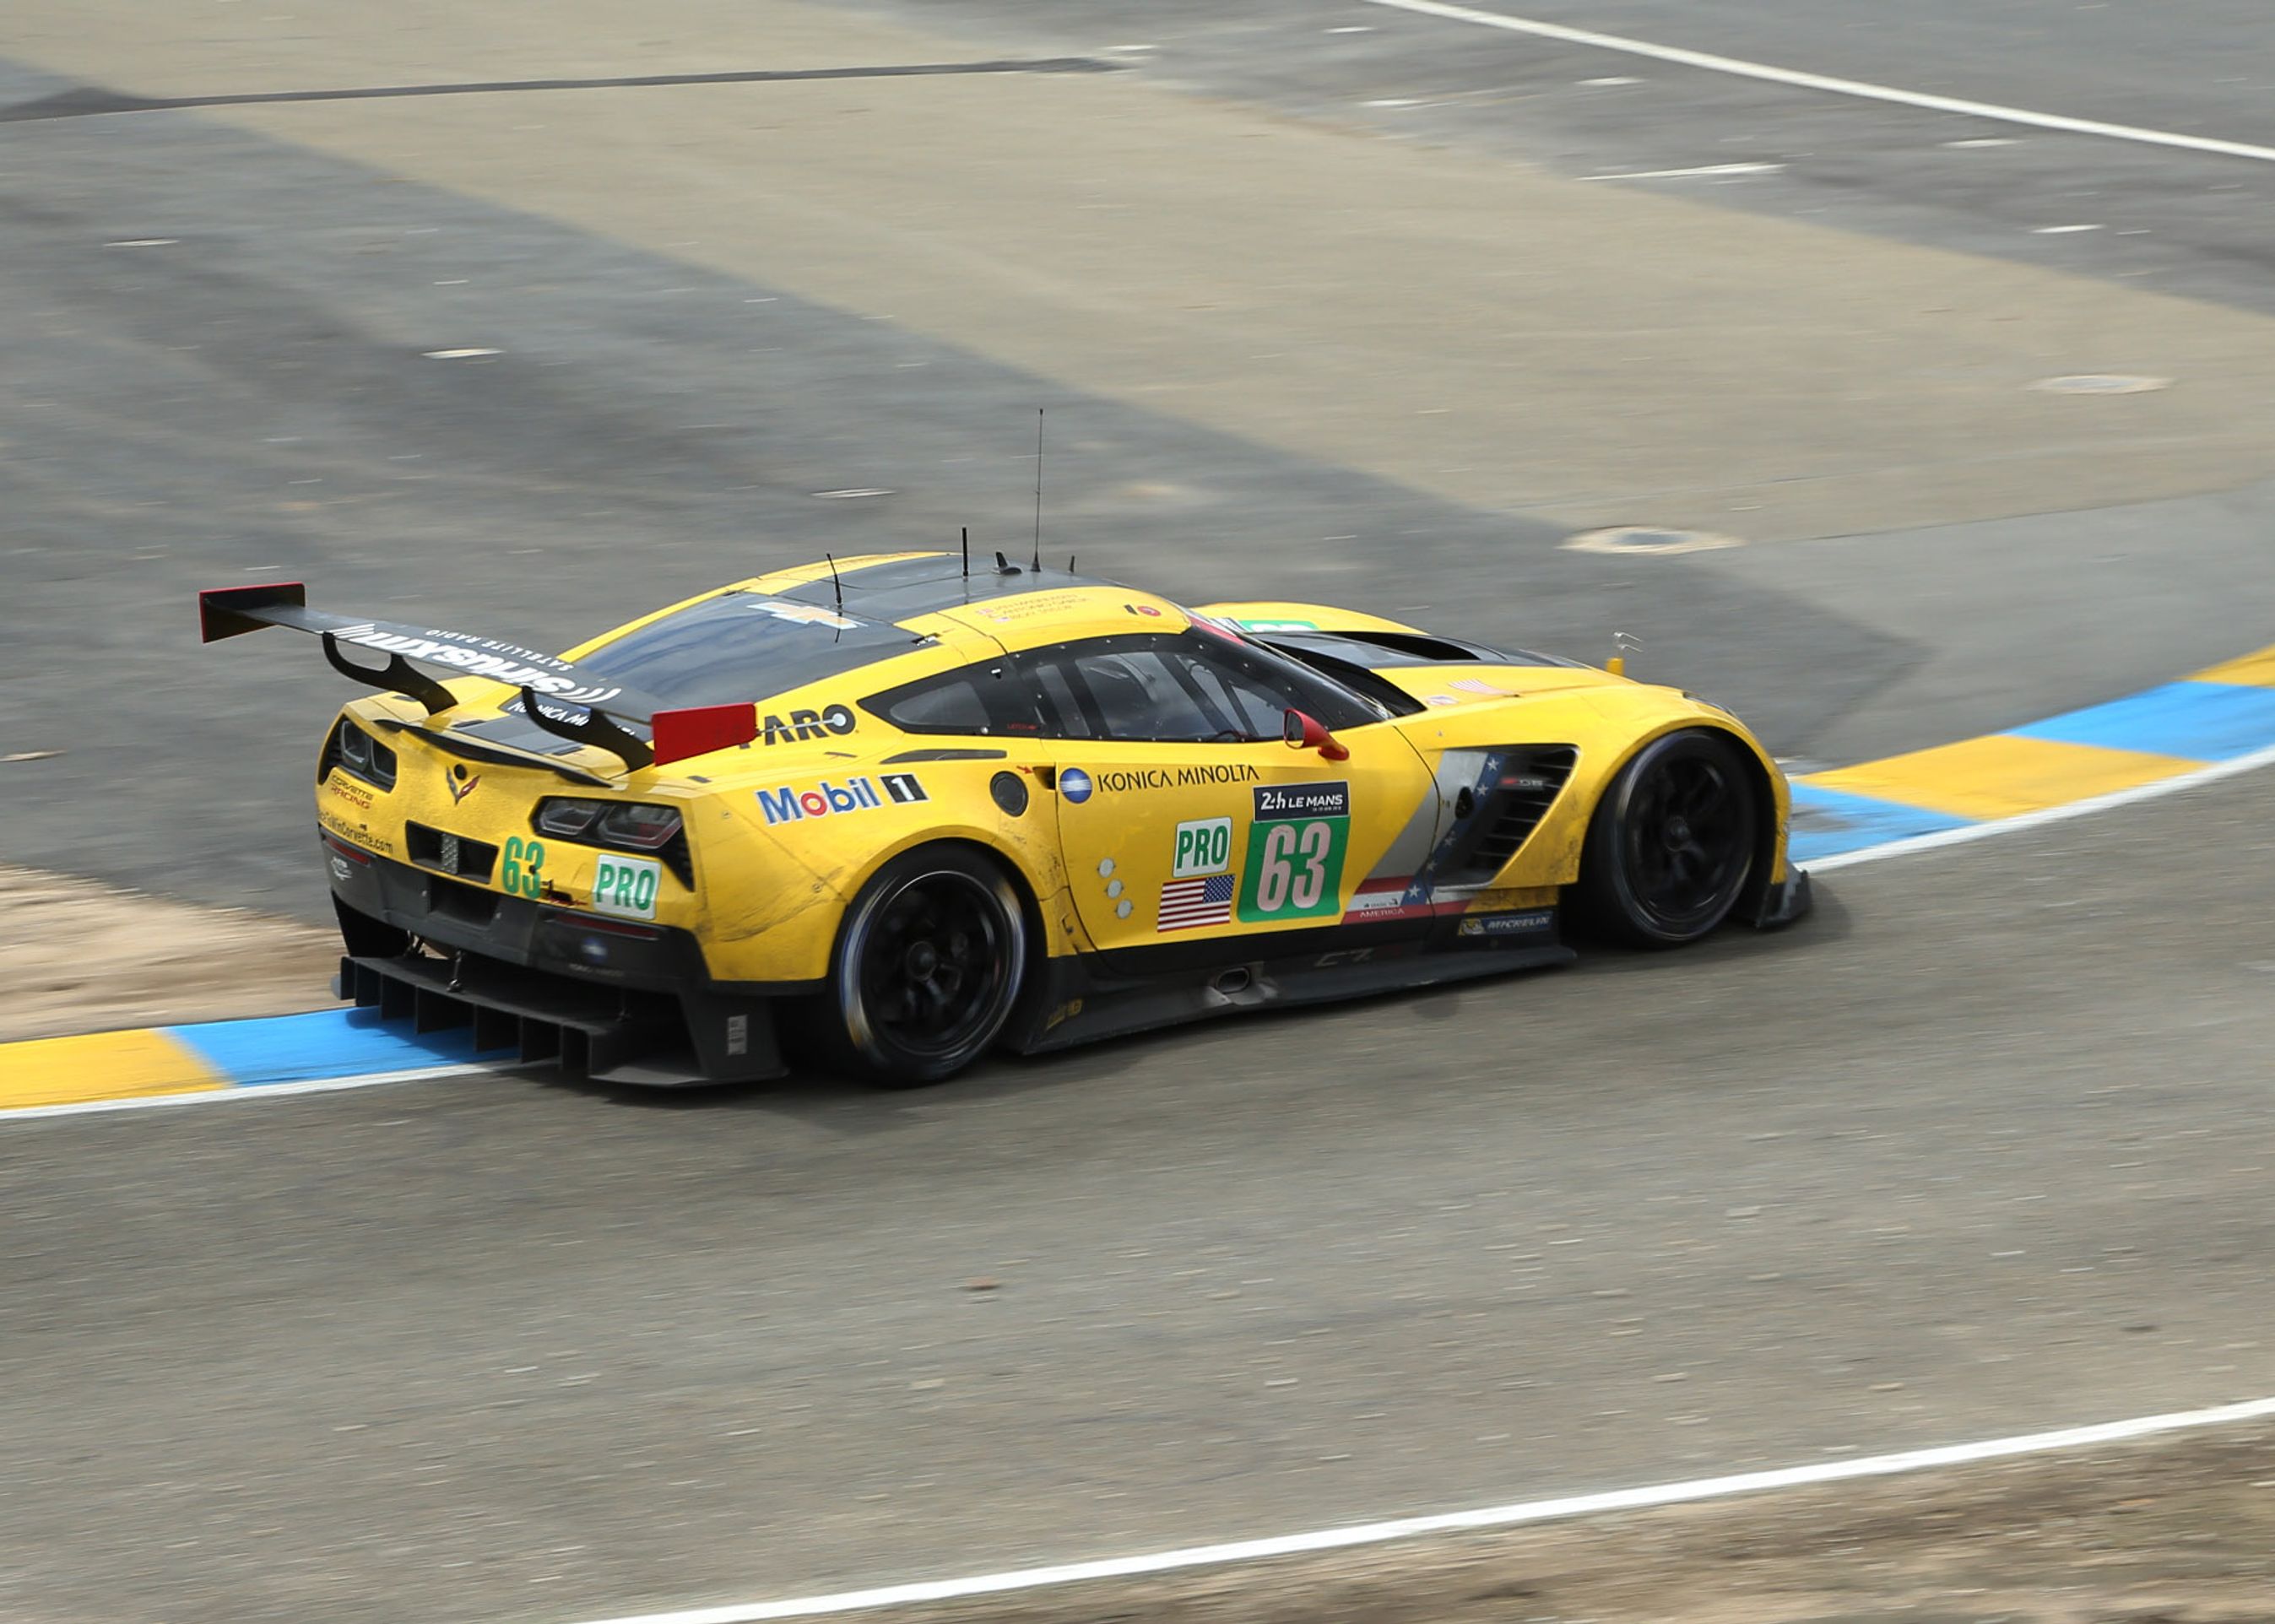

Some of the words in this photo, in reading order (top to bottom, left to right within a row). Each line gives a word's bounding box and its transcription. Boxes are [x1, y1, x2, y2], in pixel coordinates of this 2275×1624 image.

[425, 628, 482, 644] RADIO
[481, 639, 574, 672] SATELLITE
[739, 704, 856, 750] ARO
[331, 783, 371, 809] RACING
[756, 777, 882, 825] Mobil
[891, 776, 916, 801] 1
[1097, 770, 1173, 793] KONICA
[1178, 764, 1259, 786] MINOLTA
[1288, 797, 1305, 809] LE
[1306, 794, 1343, 808] MANS
[502, 836, 545, 900] 63
[1176, 825, 1228, 869] PRO
[1256, 821, 1332, 912] 63
[595, 863, 655, 912] PRO
